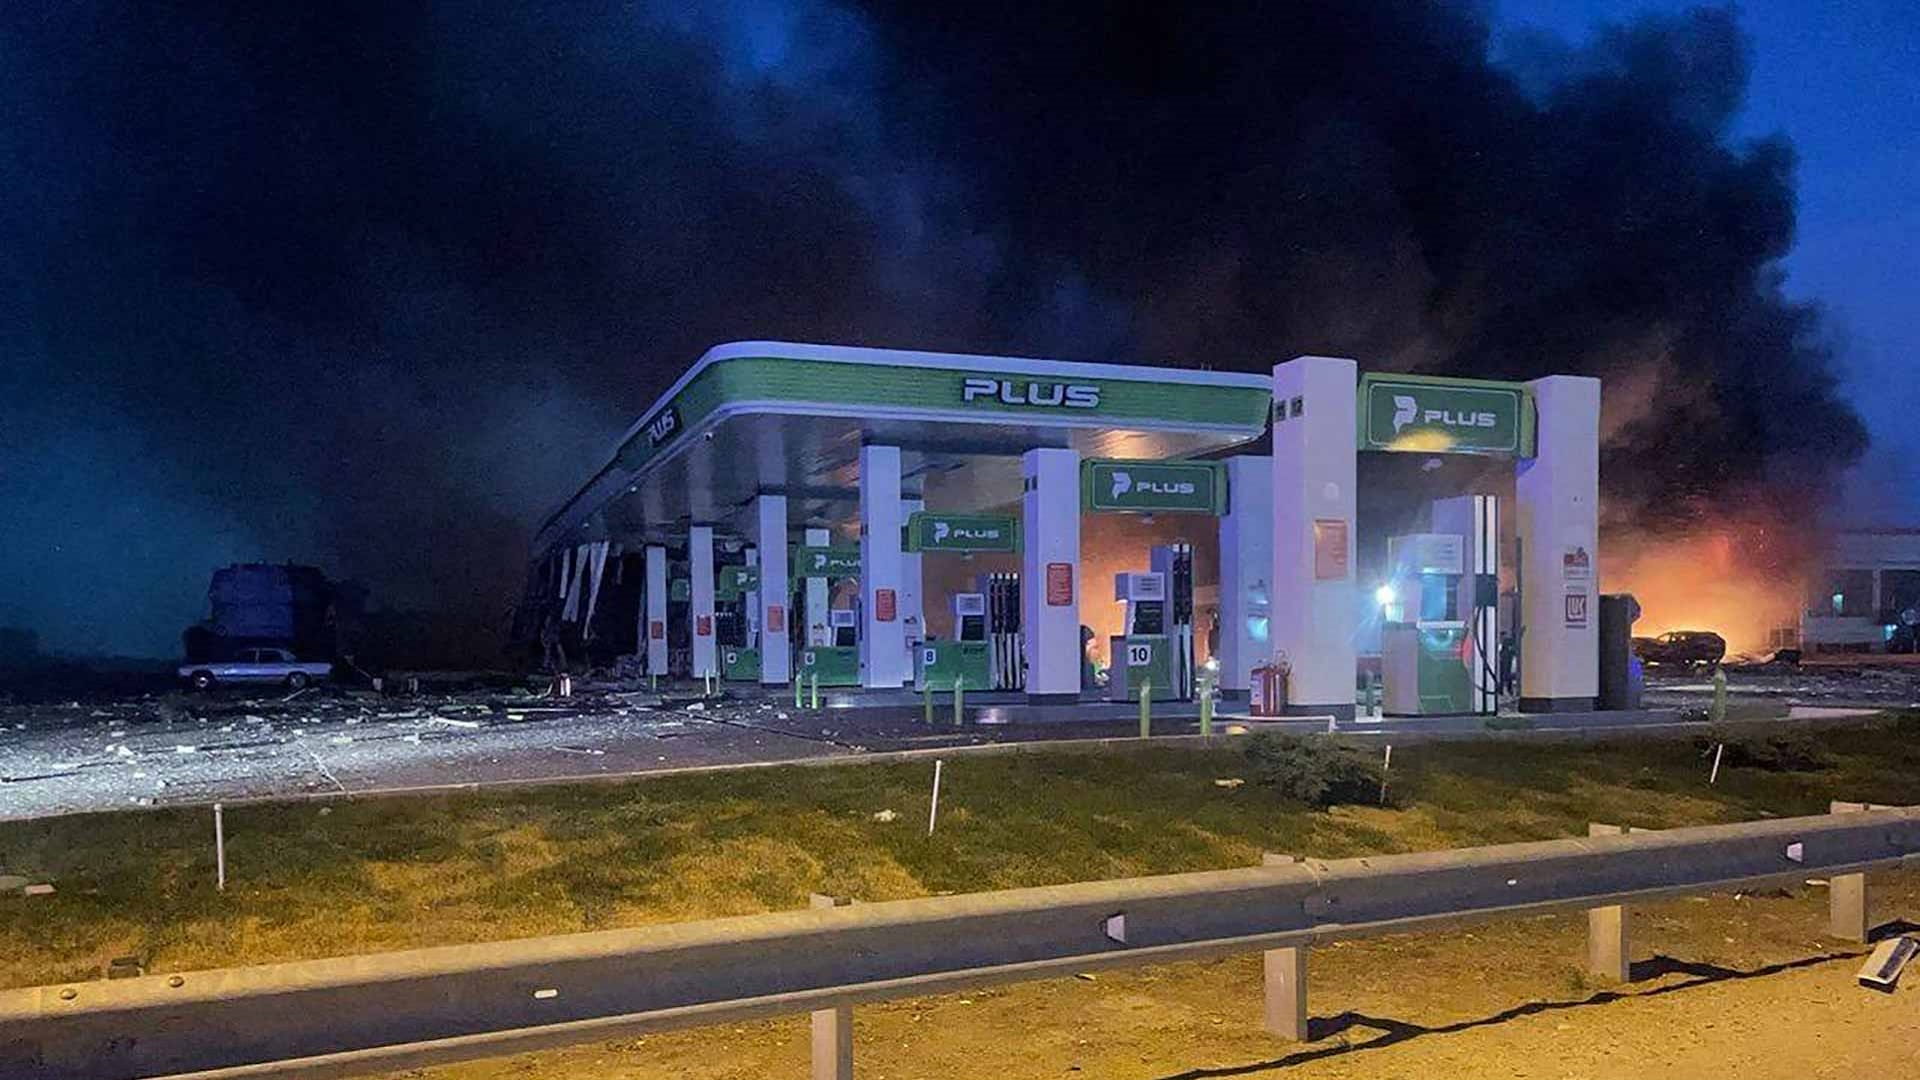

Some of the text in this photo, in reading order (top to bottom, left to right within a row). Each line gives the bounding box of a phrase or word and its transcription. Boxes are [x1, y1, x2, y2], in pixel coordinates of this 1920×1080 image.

[964, 379, 1099, 407] PLUS
[1424, 410, 1496, 427] PLUS
[1137, 481, 1195, 494] PLUS
[954, 529, 999, 539] PLUS
[926, 650, 934, 662] 8
[1130, 648, 1148, 662] 10
